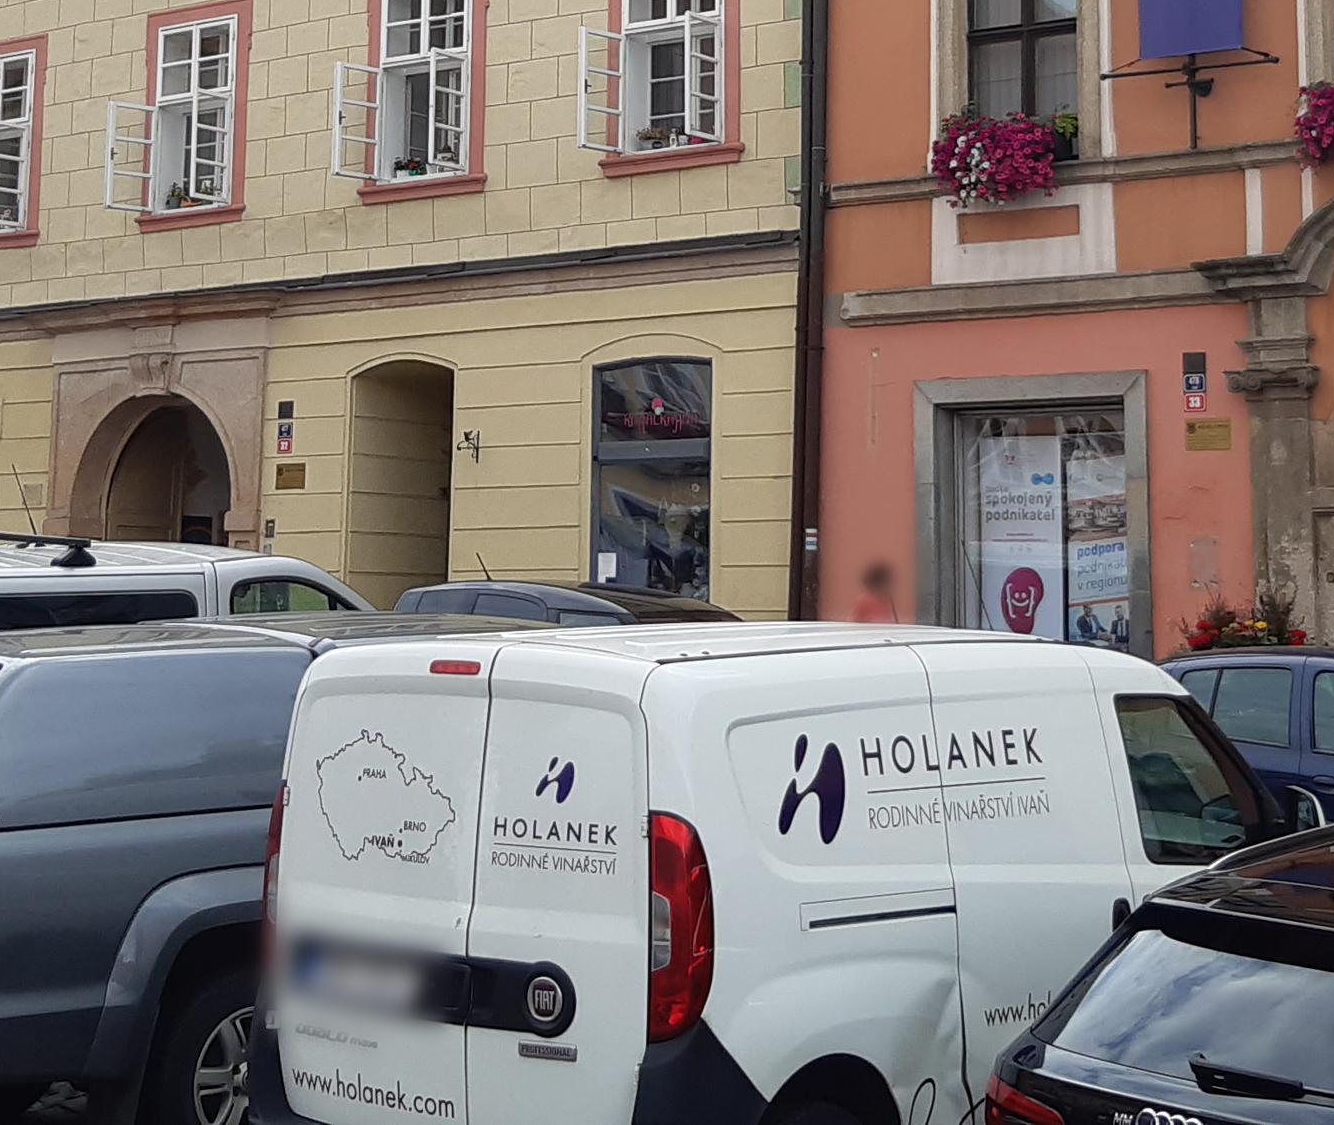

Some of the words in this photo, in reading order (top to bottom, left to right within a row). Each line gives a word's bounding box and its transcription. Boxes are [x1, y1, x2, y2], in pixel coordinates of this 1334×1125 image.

[985, 491, 1053, 507] spokojený
[985, 509, 1056, 523] podnikatel
[1077, 542, 1125, 561] podpora
[860, 728, 1043, 777] HOLANEK
[868, 798, 942, 830] RODINNÉ
[943, 792, 1015, 823] VINAŘSTVÍ
[1017, 790, 1051, 817] IVAŇ
[404, 821, 426, 832] BRNO
[493, 817, 618, 846] HOLANEK
[491, 851, 549, 870] RODINNÉ
[552, 855, 617, 875] VINAŘSTVÍ
[534, 989, 556, 1011] FIAT
[521, 1044, 571, 1057] PROFESSIONAL
[292, 1067, 456, 1120] www.holanek.com
